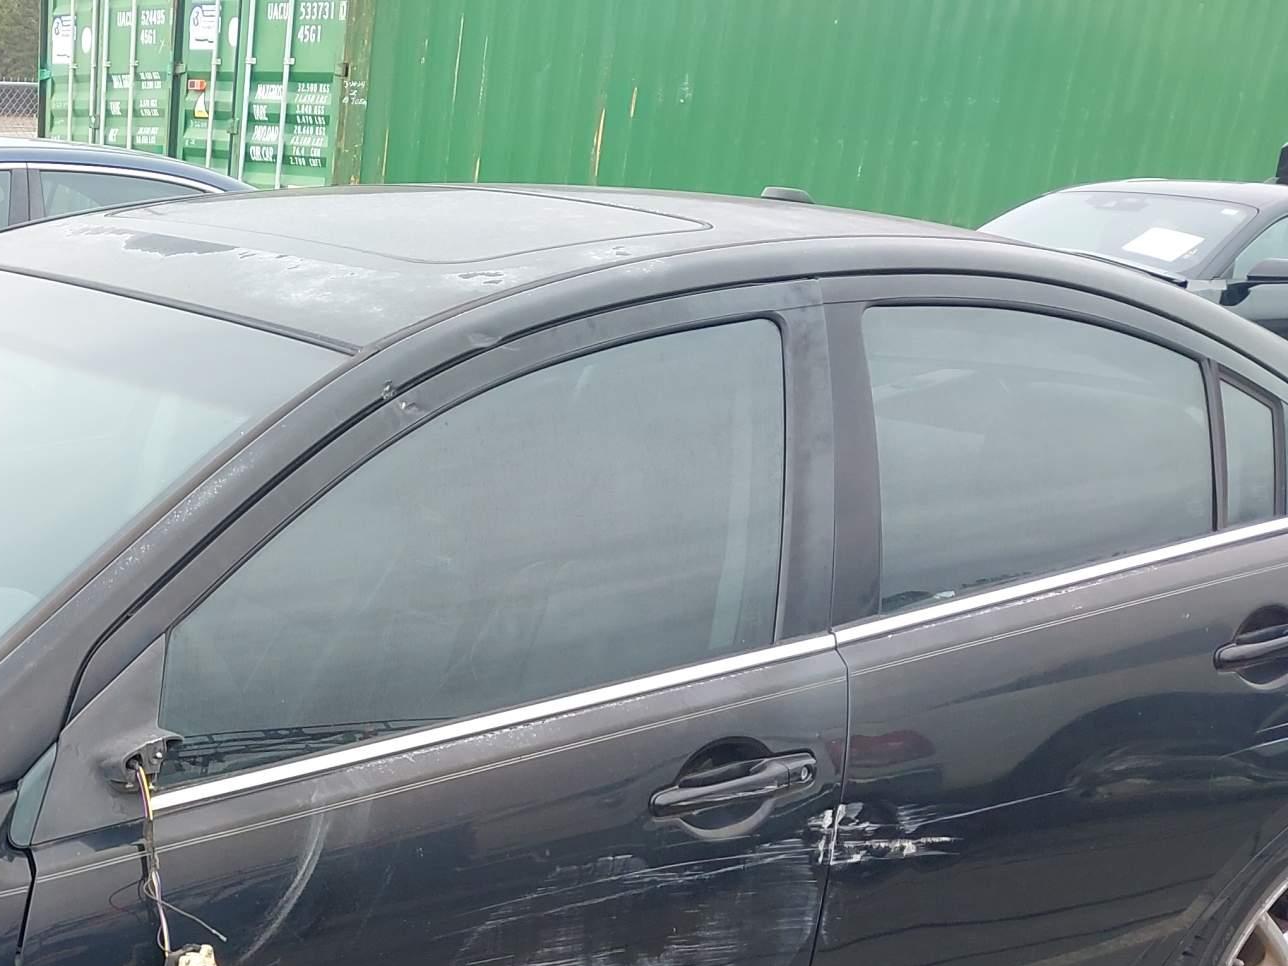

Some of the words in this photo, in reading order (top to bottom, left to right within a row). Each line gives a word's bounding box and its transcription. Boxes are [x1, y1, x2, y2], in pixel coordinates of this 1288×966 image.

[299, 2, 335, 20] 533731
[140, 29, 156, 45] 45G1
[298, 25, 322, 43] 45G1
